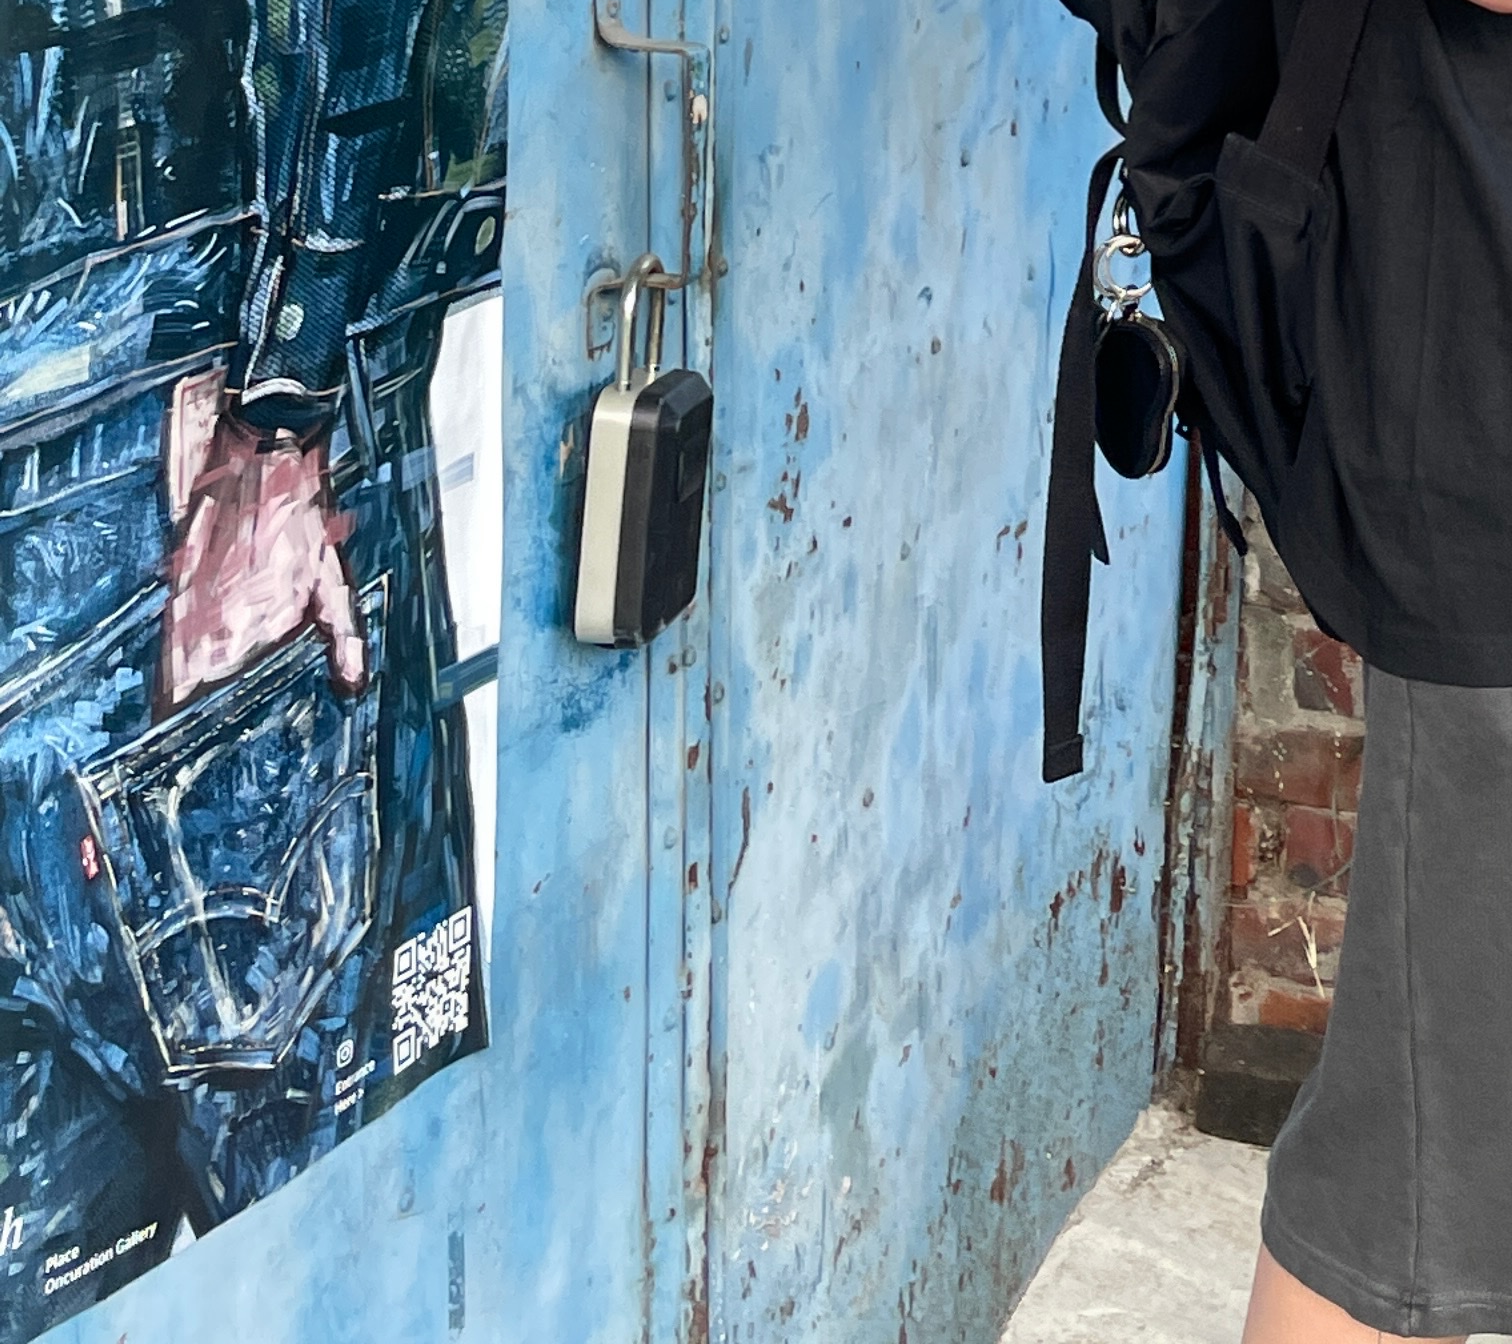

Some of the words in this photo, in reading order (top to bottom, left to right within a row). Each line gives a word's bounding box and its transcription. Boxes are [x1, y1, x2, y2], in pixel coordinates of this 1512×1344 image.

[44, 1247, 114, 1296] Oncuration
[115, 1221, 158, 1255] Gallery
[45, 1245, 81, 1274] Place
